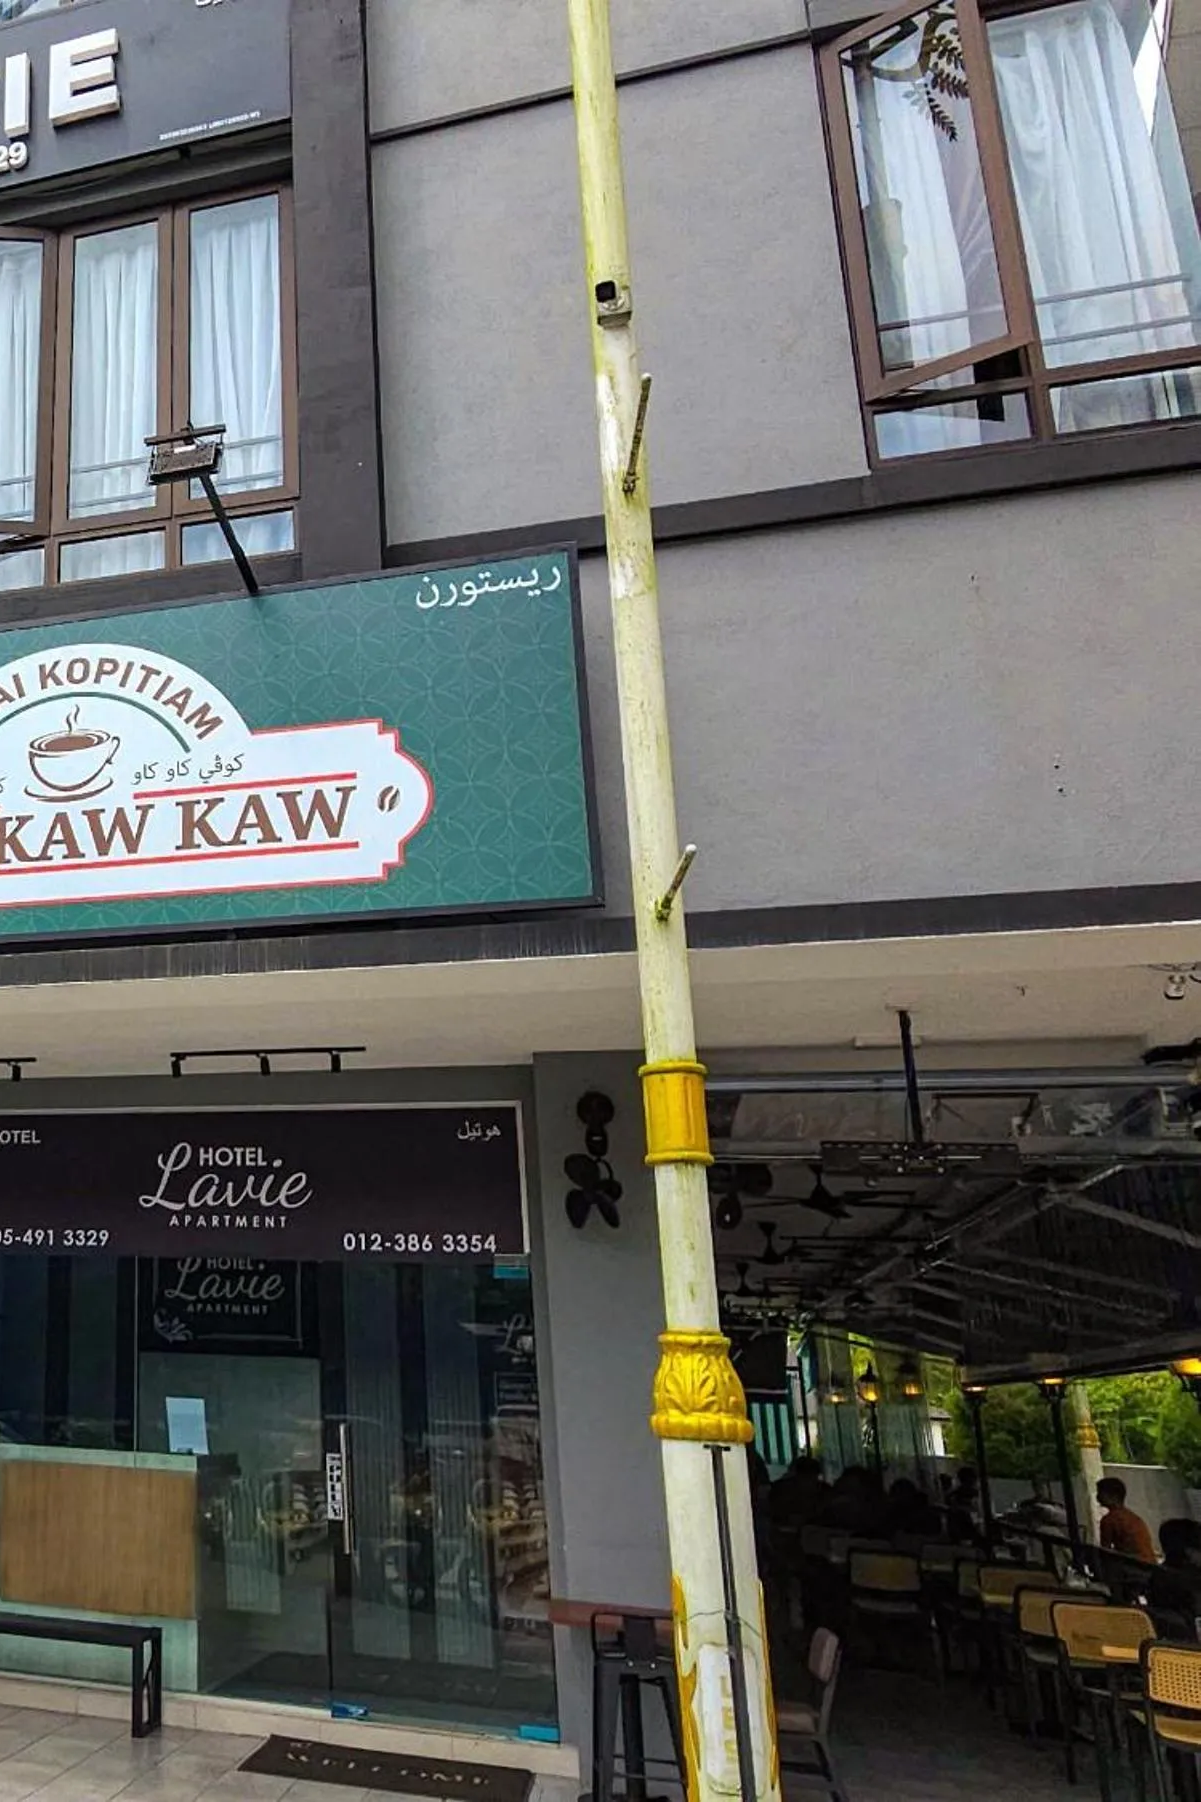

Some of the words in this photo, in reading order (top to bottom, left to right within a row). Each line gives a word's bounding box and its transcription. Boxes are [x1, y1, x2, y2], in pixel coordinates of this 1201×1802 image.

[38, 657, 224, 740] KOPITIAM
[175, 786, 357, 851] KAW
[199, 1147, 267, 1167] HOTEL
[138, 1142, 313, 1211] Lavie
[168, 1215, 287, 1229] APARTMENT
[63, 1229, 110, 1247] 3329
[343, 1233, 433, 1252] 012-386
[442, 1234, 497, 1253] 3354
[206, 1257, 254, 1271] HOTEL
[164, 1256, 286, 1301] Lavie
[186, 1303, 269, 1315] APARTMENT
